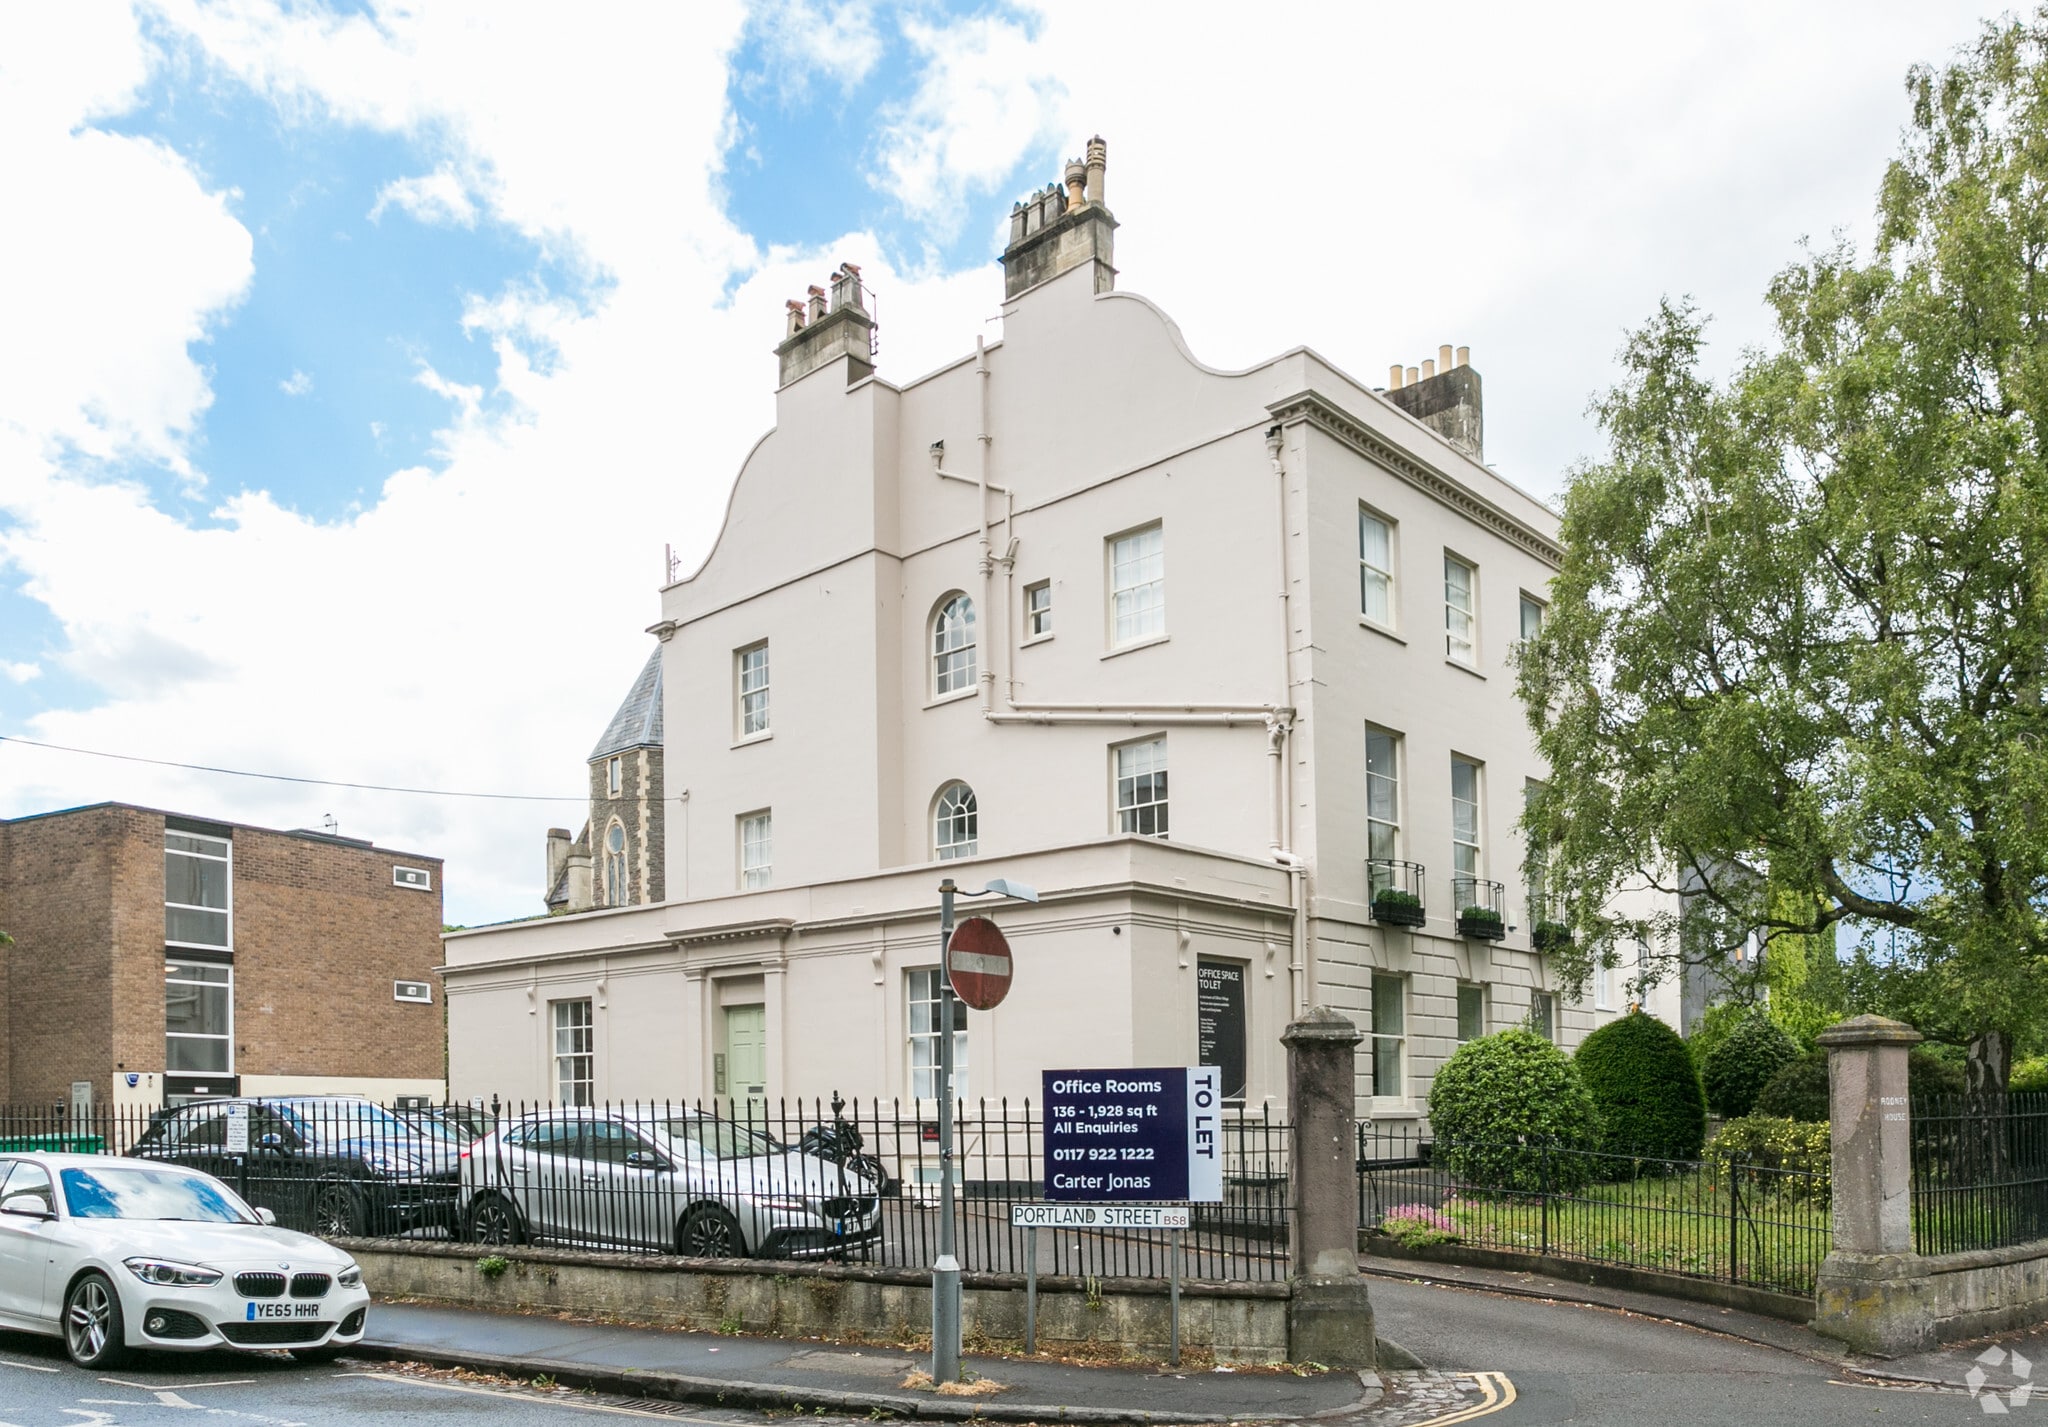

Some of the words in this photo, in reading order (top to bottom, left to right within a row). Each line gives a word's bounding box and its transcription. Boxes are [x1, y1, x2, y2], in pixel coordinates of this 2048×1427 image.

[1199, 968, 1221, 979] OFFICE
[1221, 970, 1239, 981] SPACE
[1199, 979, 1209, 989] TO
[1210, 980, 1221, 990] LET
[1052, 1080, 1102, 1094] Office
[1106, 1080, 1162, 1093] Rooms
[1195, 1075, 1213, 1108] TO
[1053, 1106, 1076, 1117] 136
[1088, 1105, 1124, 1119] 1,928
[1126, 1107, 1143, 1118] sq
[1146, 1104, 1158, 1116] ft
[1884, 1112, 1906, 1120] HOUSE
[1053, 1122, 1072, 1134] All
[1076, 1122, 1138, 1135] Enquiries
[1195, 1116, 1213, 1160] LET
[1053, 1148, 1084, 1160] 0117
[1088, 1148, 1117, 1160] 922
[1120, 1148, 1154, 1160] 1222
[1053, 1174, 1103, 1189] Carter
[1106, 1173, 1151, 1192] Jonas
[1014, 1207, 1096, 1224] PORTLAND
[1104, 1208, 1162, 1225] STREET
[1163, 1215, 1187, 1226] BS8
[257, 1304, 292, 1317] YE65
[295, 1304, 319, 1317] HHR
